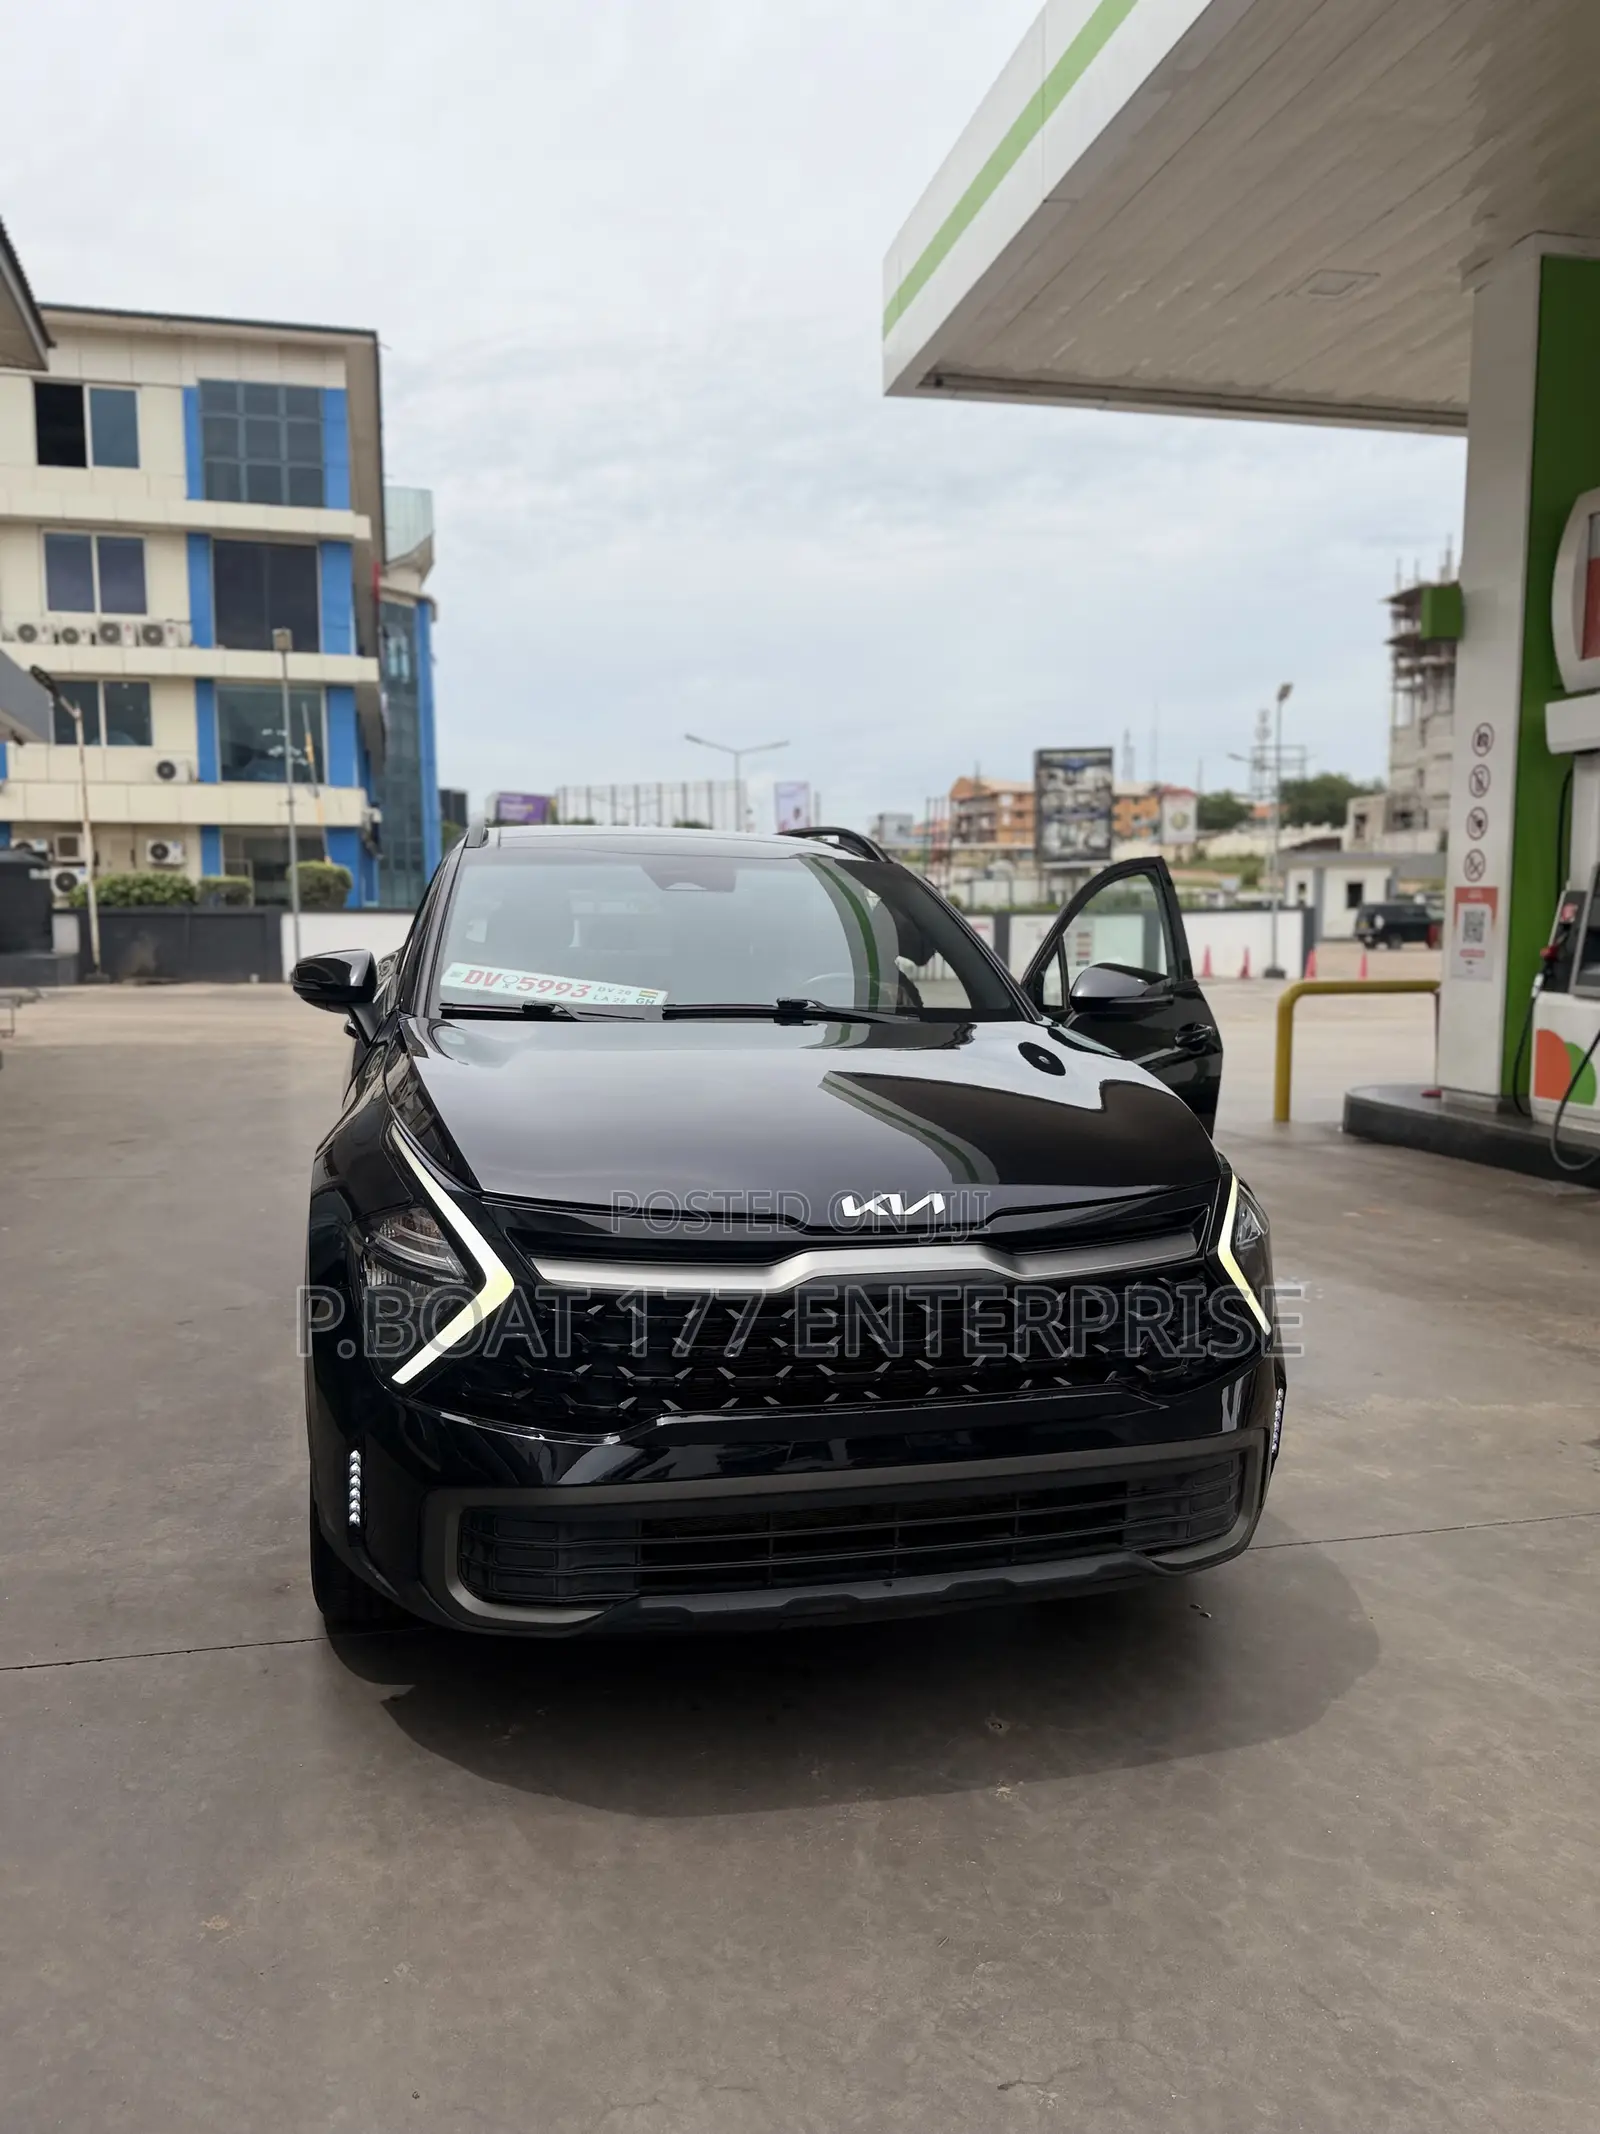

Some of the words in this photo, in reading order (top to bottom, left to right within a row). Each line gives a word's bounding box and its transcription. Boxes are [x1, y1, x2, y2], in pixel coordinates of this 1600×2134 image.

[462, 969, 503, 987] DV
[516, 977, 592, 998] 5993
[636, 997, 655, 1006] GH
[841, 1193, 946, 1218] KIA
